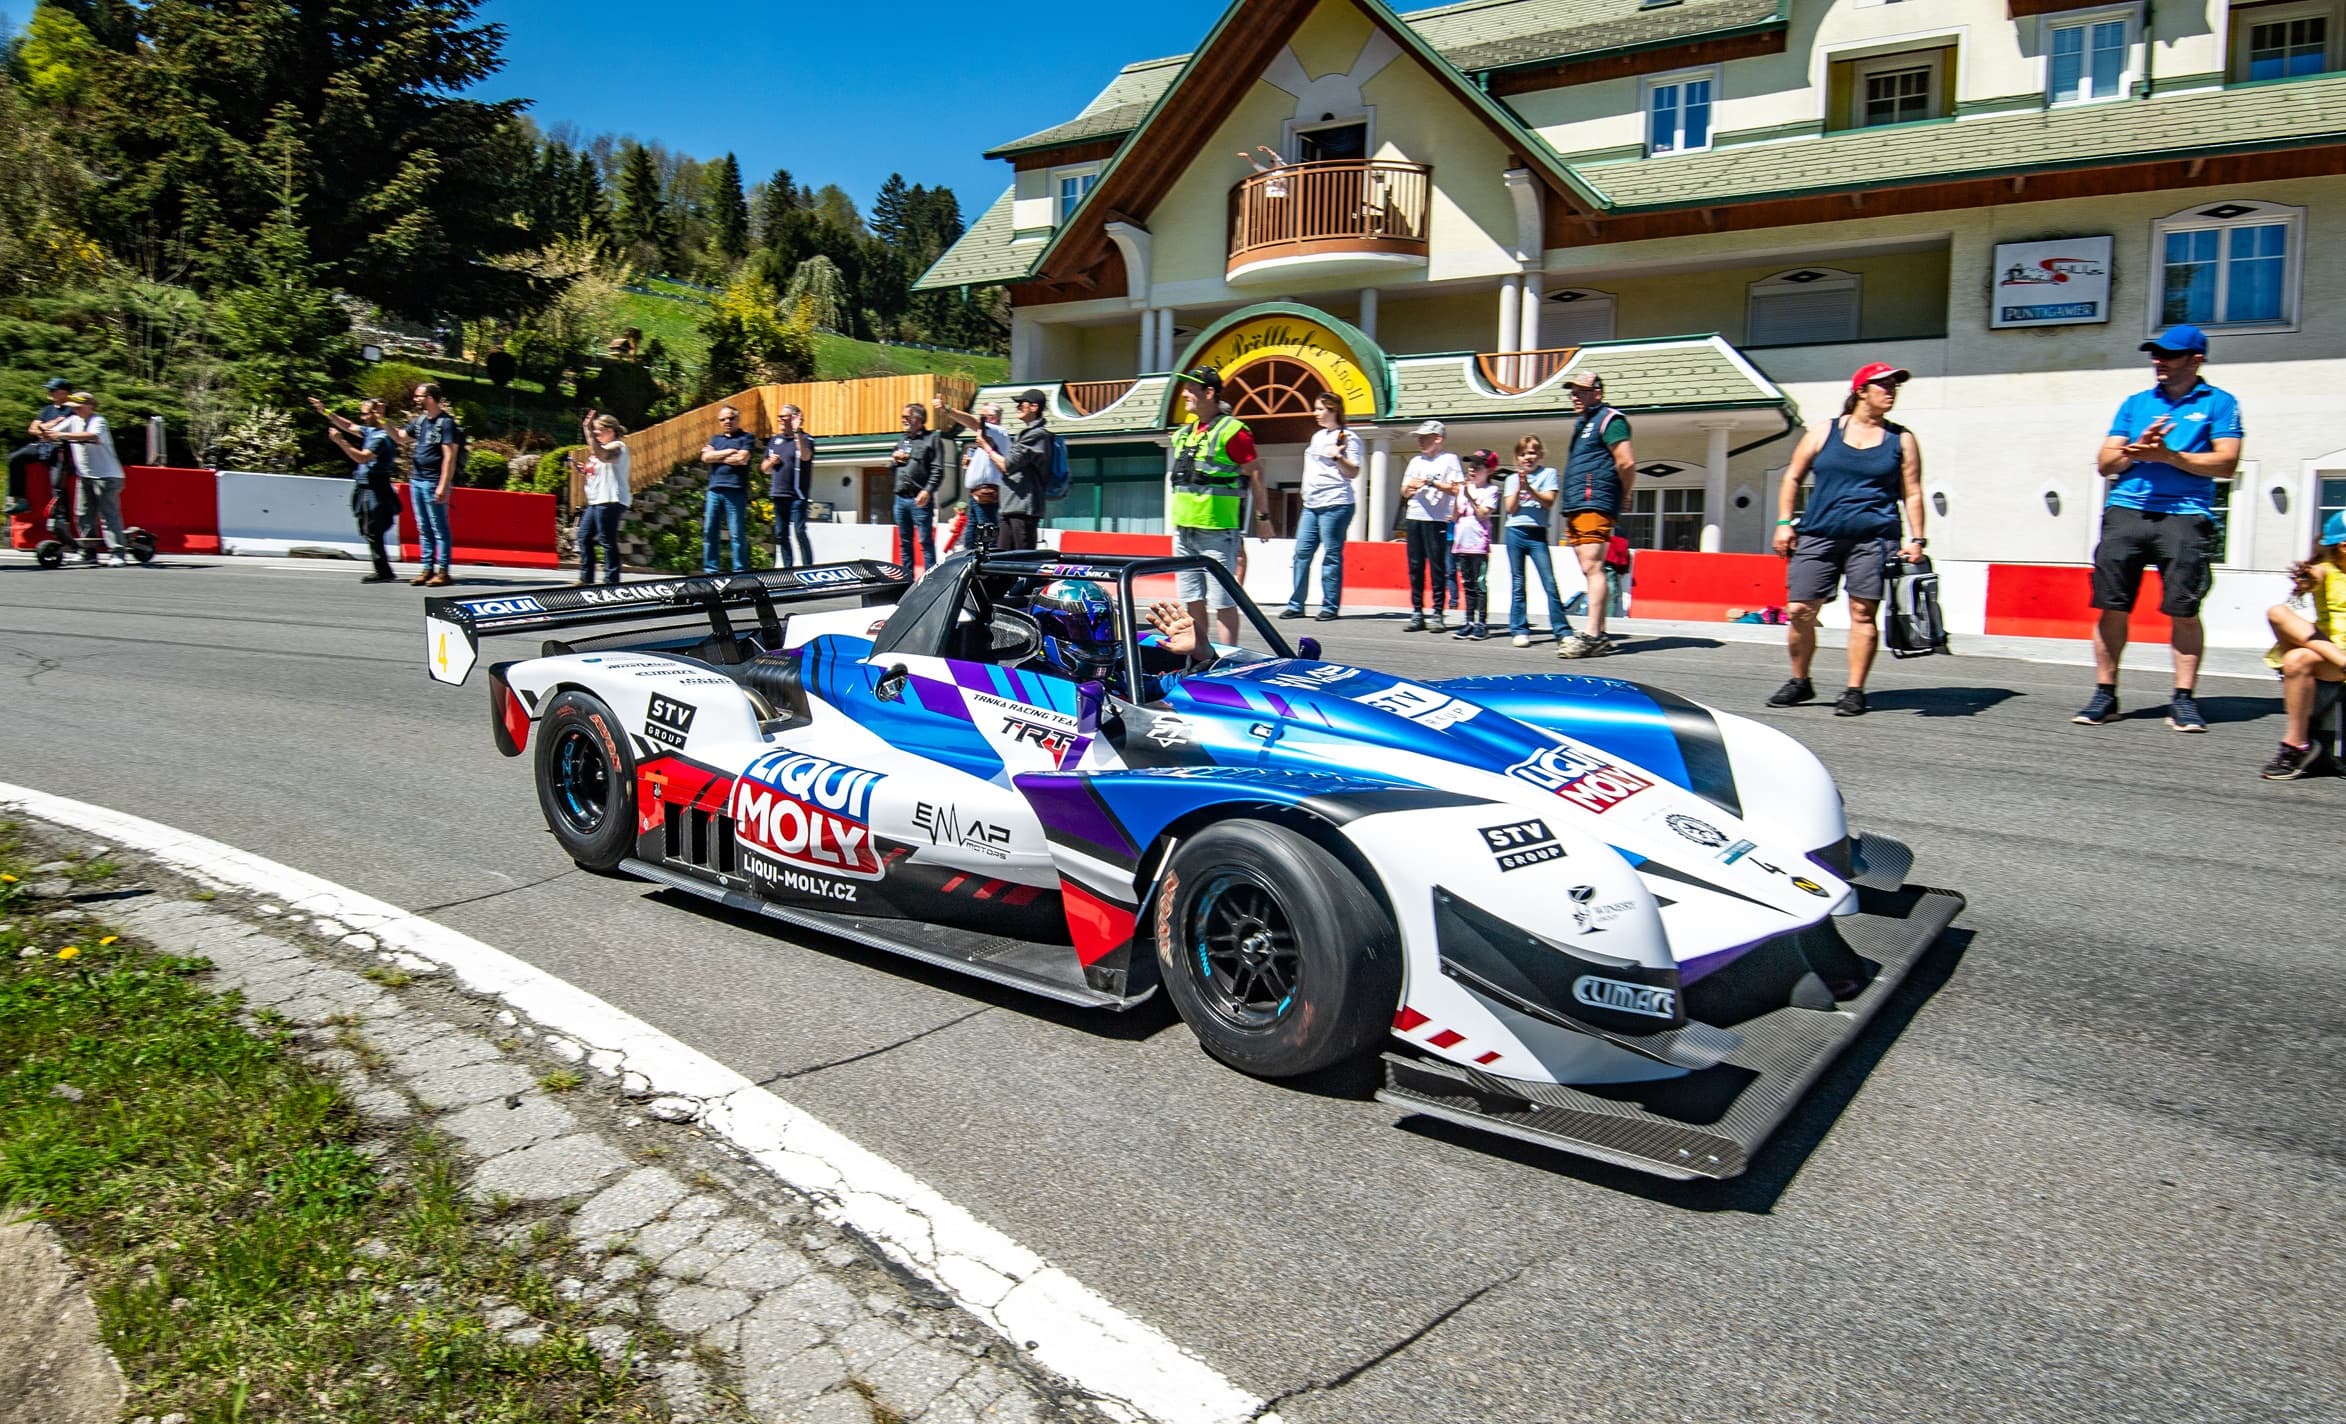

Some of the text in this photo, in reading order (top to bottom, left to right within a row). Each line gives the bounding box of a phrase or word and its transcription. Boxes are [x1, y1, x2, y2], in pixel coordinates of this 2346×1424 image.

[799, 568, 855, 583] LIQUI
[580, 584, 675, 604] RACING
[473, 599, 534, 617] IQUI
[438, 633, 448, 672] 4
[652, 700, 690, 725] STV
[974, 694, 1006, 709] TRNKA
[1009, 704, 1049, 719] RACING
[1367, 691, 1427, 713] STV
[648, 726, 682, 745] GROUP
[1001, 716, 1075, 750] TRT
[1516, 749, 1607, 790] LIQUI
[749, 750, 880, 818] LIQUI
[1559, 767, 1650, 812] MOLY
[737, 783, 867, 867] MOLY
[1488, 823, 1544, 847] STV
[966, 842, 1007, 860] MOTORS
[1502, 847, 1560, 868] GROUP
[744, 854, 857, 902] LIQUI-MOLY.CZ
